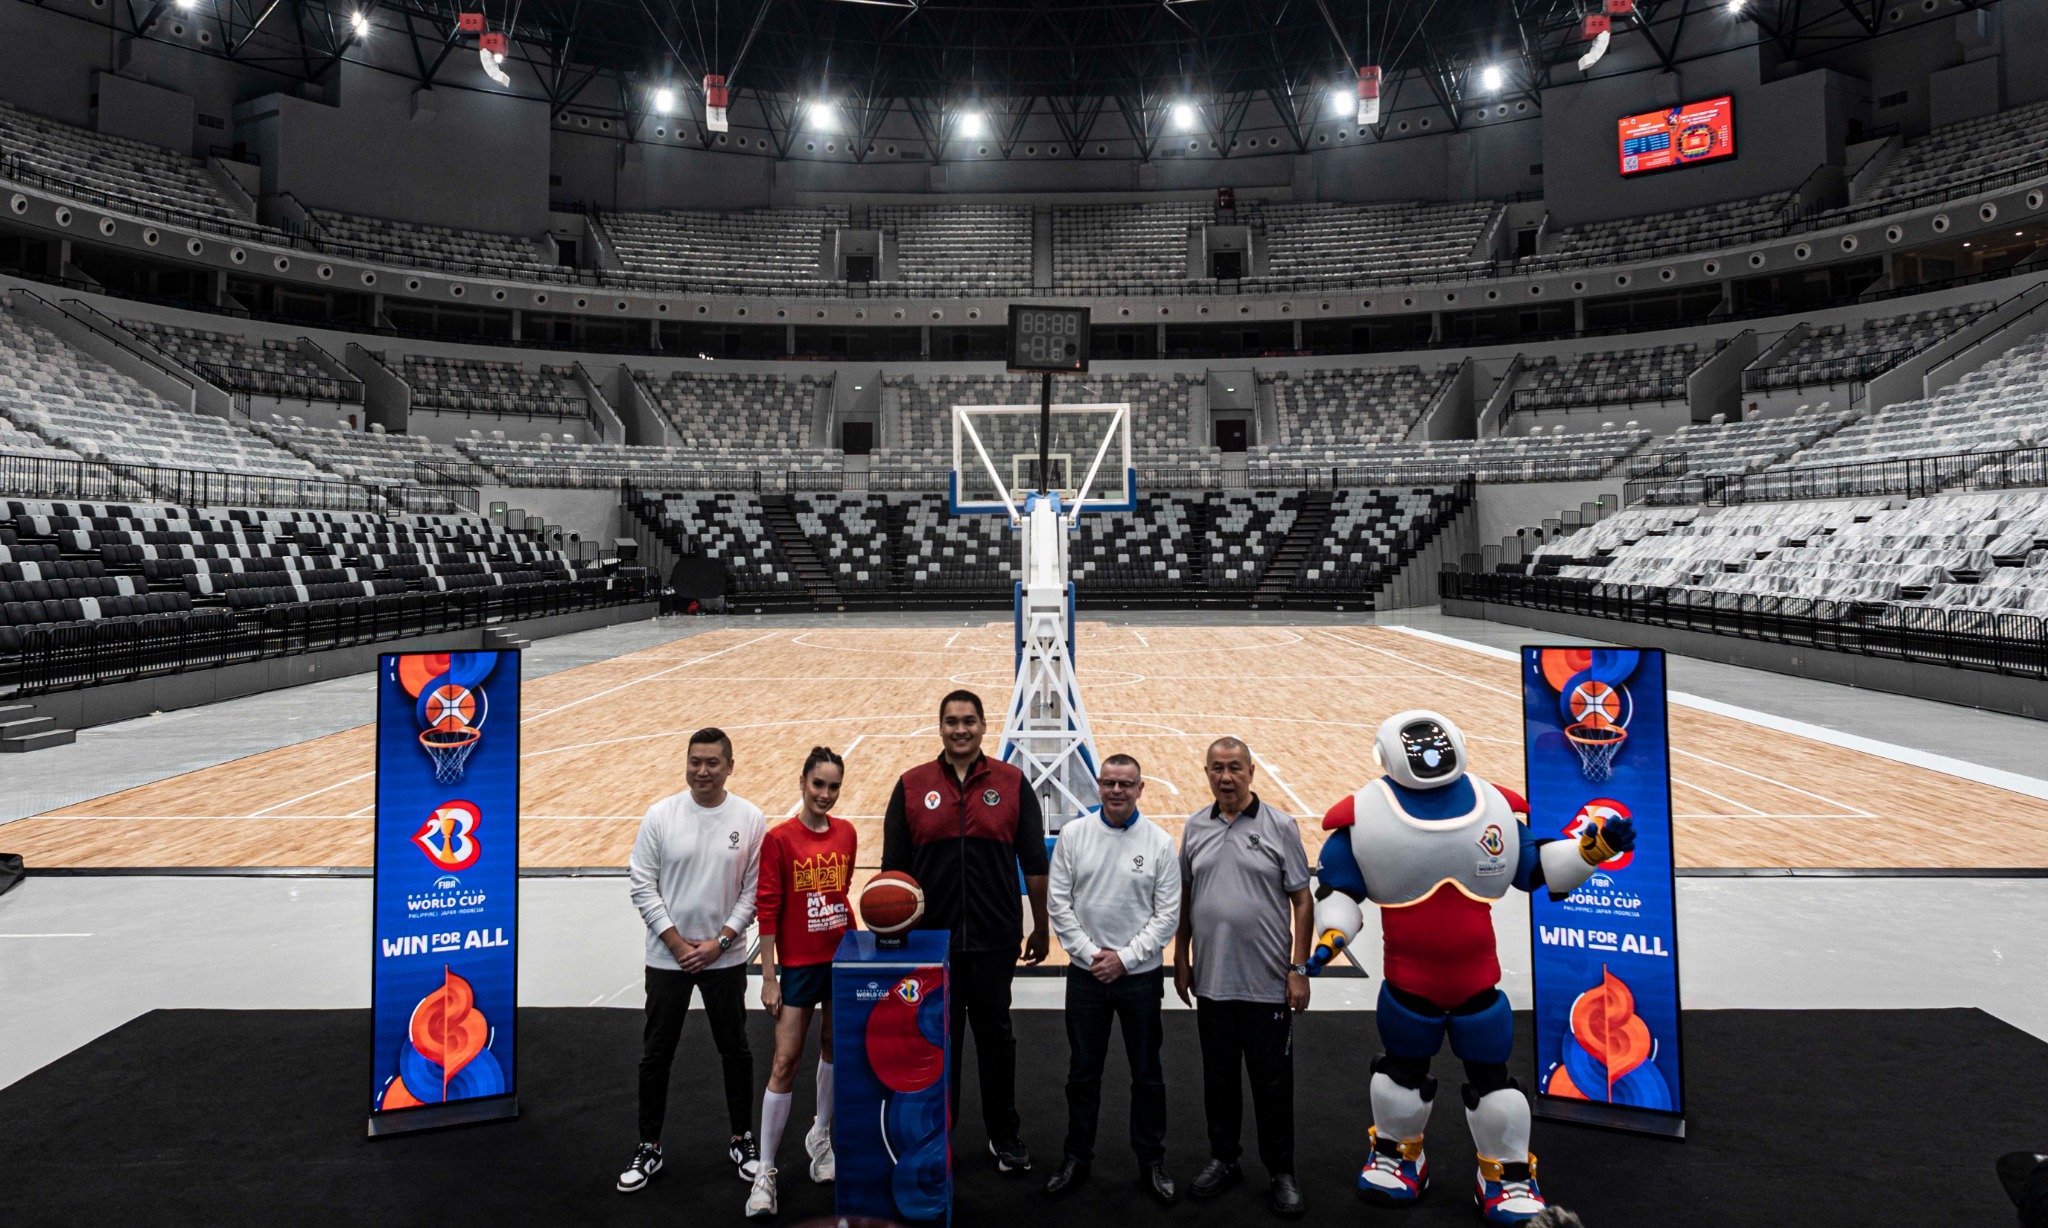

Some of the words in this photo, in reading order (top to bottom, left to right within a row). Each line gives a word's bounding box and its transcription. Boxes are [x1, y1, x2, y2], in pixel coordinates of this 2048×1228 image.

[819, 866, 837, 888] 23
[1591, 878, 1610, 887] FIBA
[438, 880, 456, 889] FIBA
[408, 889, 484, 899] BASKETBALL
[1578, 887, 1639, 898] SKETBALL
[407, 897, 456, 910] WORLD
[459, 894, 486, 906] CUP
[807, 895, 826, 908] MY
[1564, 893, 1611, 906] WORLD
[1613, 897, 1642, 909] CUP
[408, 911, 439, 919] PHILIPPINES
[807, 903, 848, 918] GANG.
[1563, 905, 1593, 913] PHILIPPINES
[1613, 909, 1640, 917] INDONESIA
[382, 934, 428, 957] WIN
[432, 931, 461, 946] FOR
[464, 928, 509, 950] ALL
[1539, 925, 1585, 948] WIN
[1588, 930, 1618, 945] FOR
[1621, 933, 1668, 957] ALL
